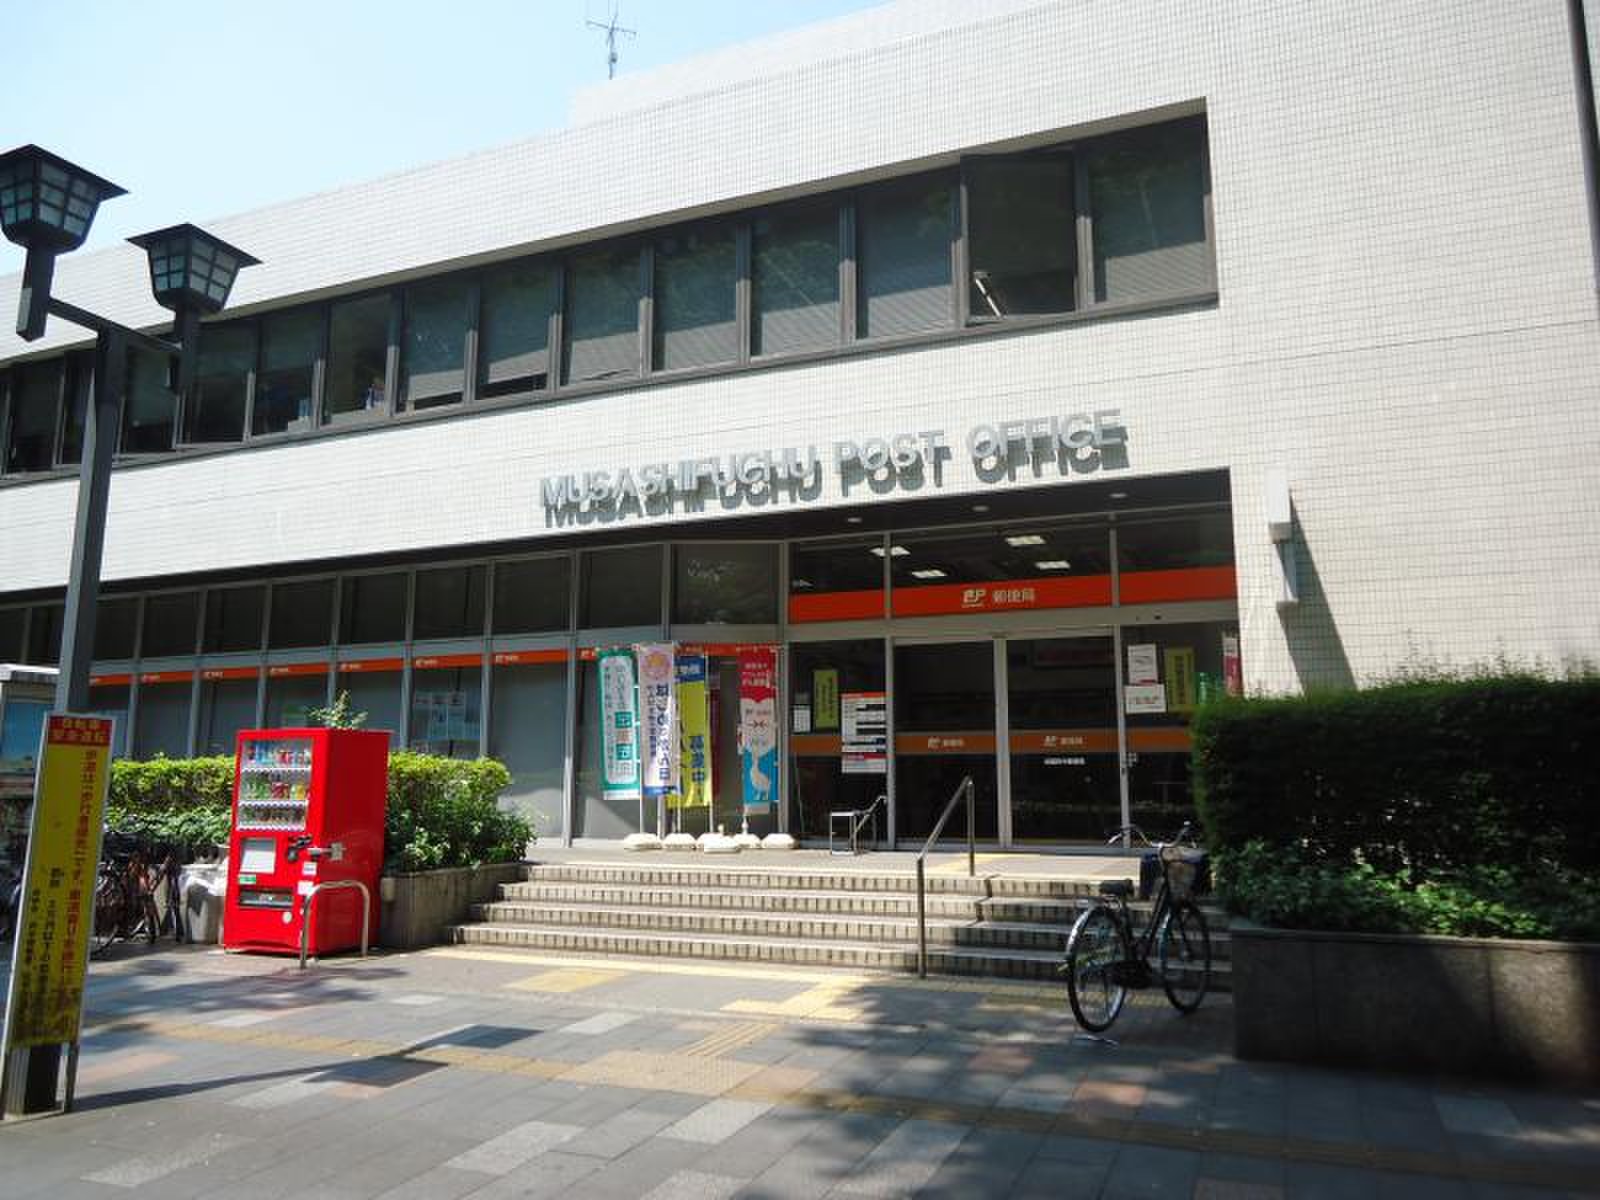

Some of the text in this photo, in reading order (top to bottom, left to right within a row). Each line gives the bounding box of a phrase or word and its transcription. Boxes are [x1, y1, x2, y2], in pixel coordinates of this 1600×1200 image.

[541, 409, 1120, 506] MUSASHIFUCHU POST OFFICE
